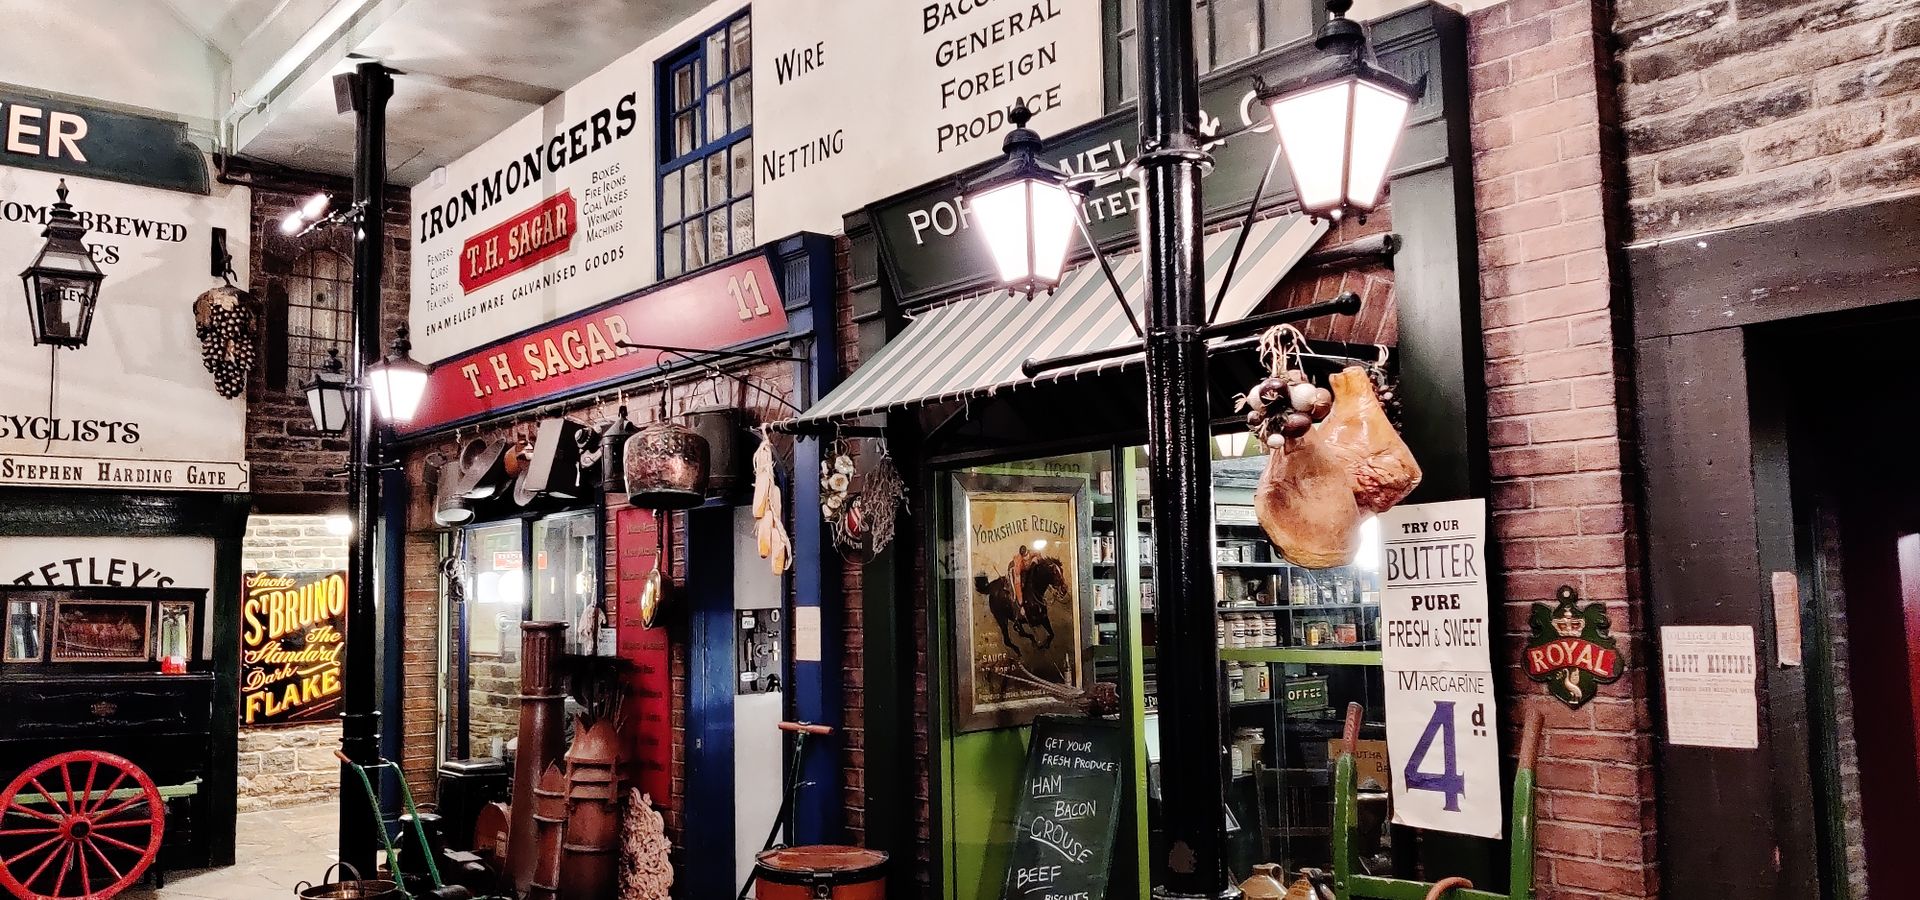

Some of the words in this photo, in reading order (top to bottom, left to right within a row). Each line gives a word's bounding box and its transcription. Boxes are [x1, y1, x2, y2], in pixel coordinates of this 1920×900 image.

[923, 0, 996, 34] BAC
[935, 0, 1061, 67] GENERAL
[775, 41, 825, 86] WIRE
[940, 41, 1057, 109] FOREIGN
[937, 84, 1062, 154] PRODUCE
[5, 104, 88, 163] ER
[420, 92, 636, 244] IRONMONGERS
[762, 129, 844, 185] NETTING
[592, 163, 620, 184] BOXES
[583, 201, 602, 215] COAL
[603, 189, 628, 206] VASES
[585, 187, 601, 201] FIRE
[603, 175, 626, 193] IRONS
[587, 205, 623, 228] WRINGING
[1082, 187, 1140, 224] ITED
[0, 201, 48, 224] OM
[77, 211, 187, 242] BREWED
[508, 202, 569, 259] SAGAR
[586, 220, 623, 243] MACHINES
[87, 243, 119, 265] ES
[427, 247, 454, 266] FENDERS
[430, 265, 448, 279] CURBS
[426, 306, 476, 336] ENAMELLED
[480, 295, 504, 313] WARE
[512, 265, 576, 300] GALVANISED
[585, 245, 625, 271] GOODS
[431, 281, 448, 295] BATHS
[531, 314, 639, 382] SAGAR
[727, 270, 770, 320] 11
[2, 457, 83, 480] STEPHEN
[97, 462, 173, 484] HARDING
[186, 465, 226, 485] GATE
[972, 518, 1028, 546] YORKSHIRE
[1032, 514, 1066, 539] RELISH
[1402, 521, 1428, 534] TRY
[1433, 519, 1460, 532] OUR
[1386, 543, 1478, 582] BUTTER
[246, 572, 296, 589] Smoke
[269, 574, 345, 639] BRUNO
[1411, 594, 1461, 611] PURE
[305, 625, 342, 643] The
[1388, 619, 1430, 649] FRESH
[1434, 628, 1441, 647] &
[1445, 618, 1483, 647] SWEET
[244, 641, 344, 666] Standard
[1530, 642, 1609, 676] ROYAL
[242, 663, 298, 692] Dark
[245, 667, 341, 724] FLAKE
[1287, 688, 1322, 700] OFFEE
[1045, 737, 1064, 749] GET
[1067, 740, 1091, 752] YOUR
[1404, 700, 1466, 812] 4
[1042, 753, 1071, 768] FRESH
[1032, 775, 1062, 795] HAM
[1054, 800, 1096, 817] BACON
[1017, 865, 1061, 889] BEEF
